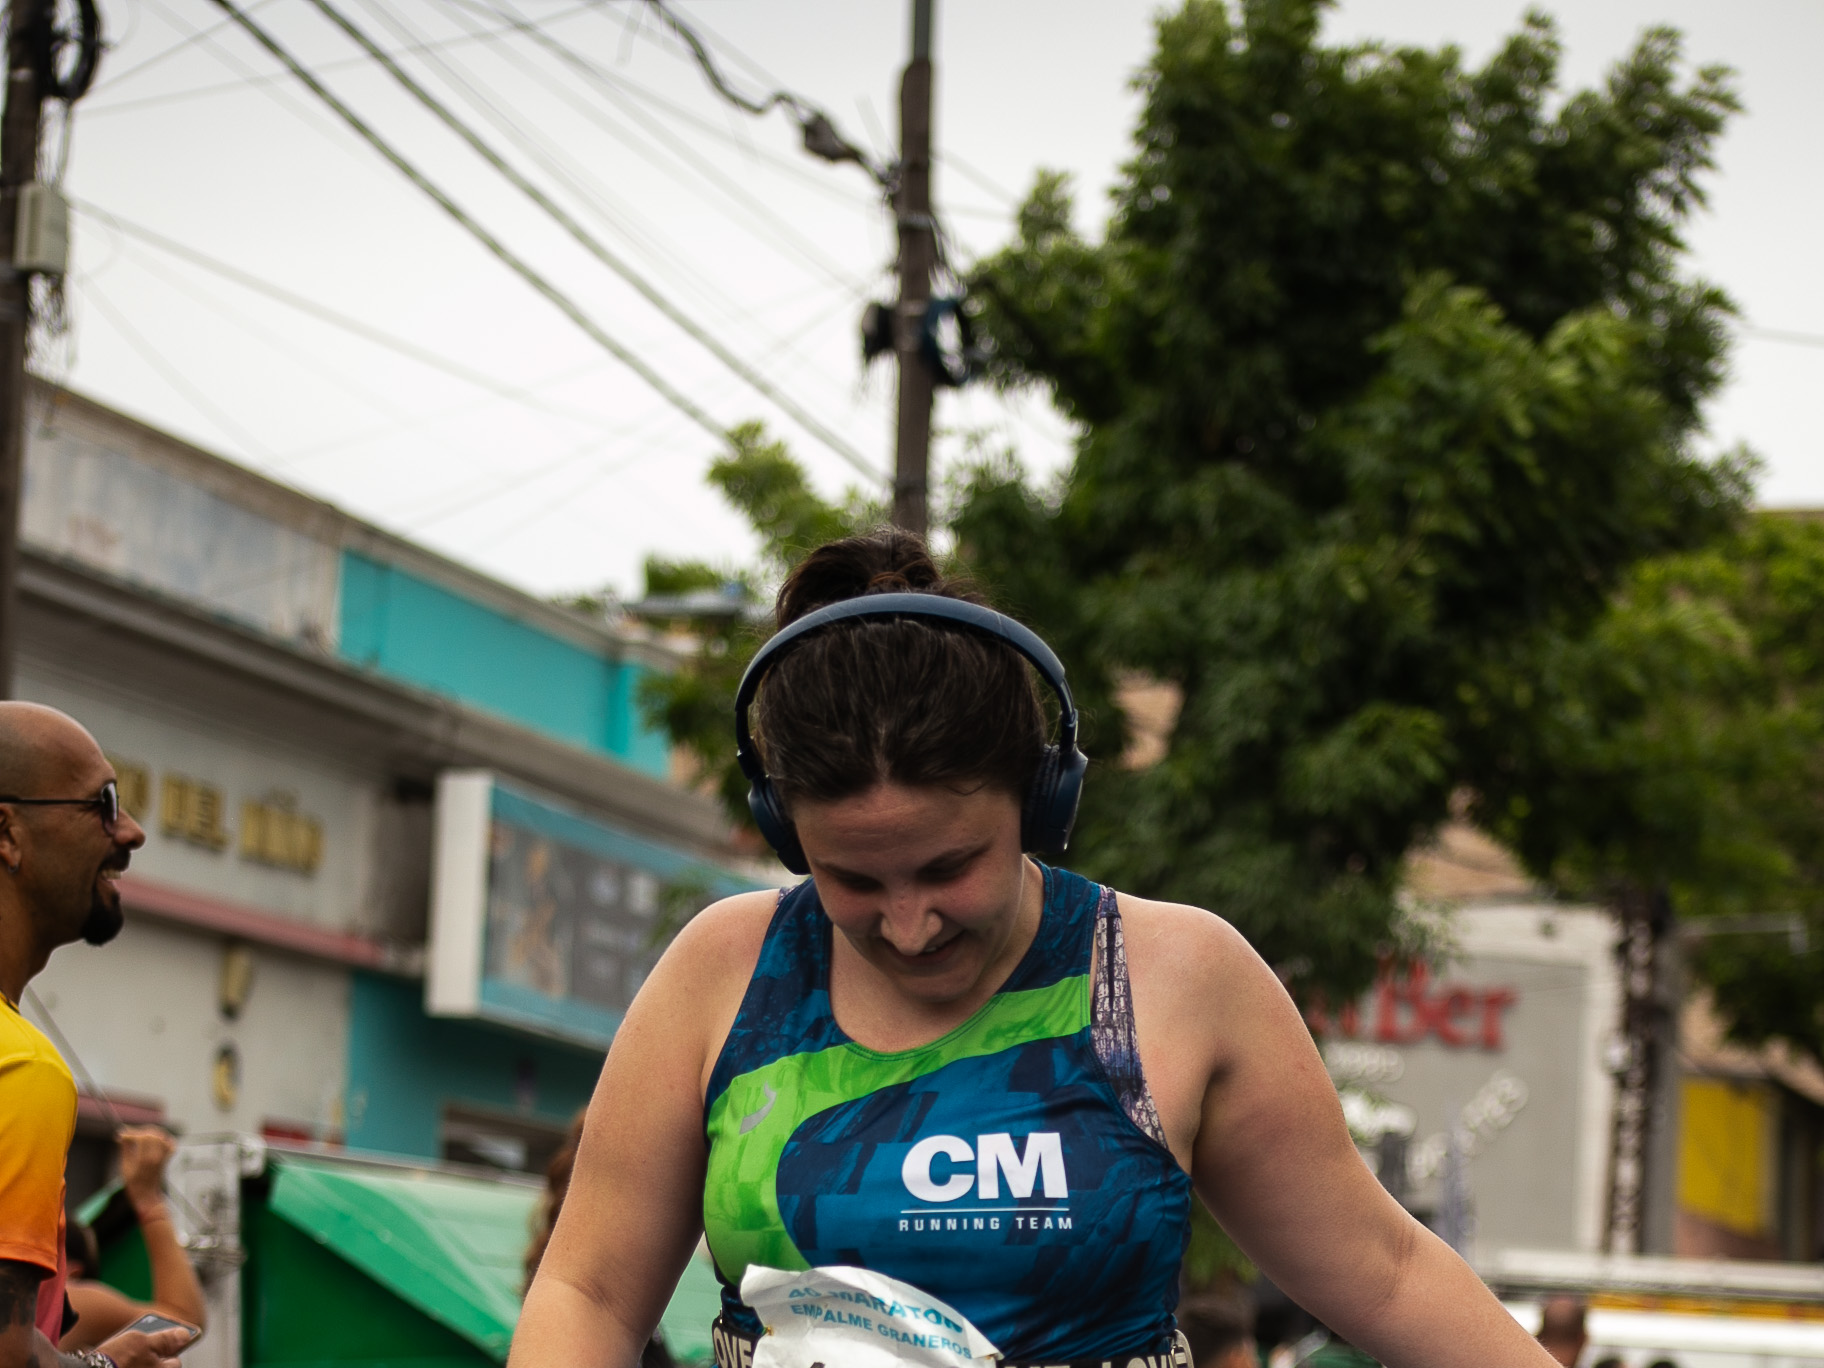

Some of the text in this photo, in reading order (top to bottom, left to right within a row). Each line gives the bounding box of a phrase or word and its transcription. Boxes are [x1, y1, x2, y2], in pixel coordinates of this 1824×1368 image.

[901, 1132, 1069, 1202] CM
[898, 1217, 1073, 1232] RUNNING TEAM
[791, 1303, 973, 1360] EMPALME GRANEROS
